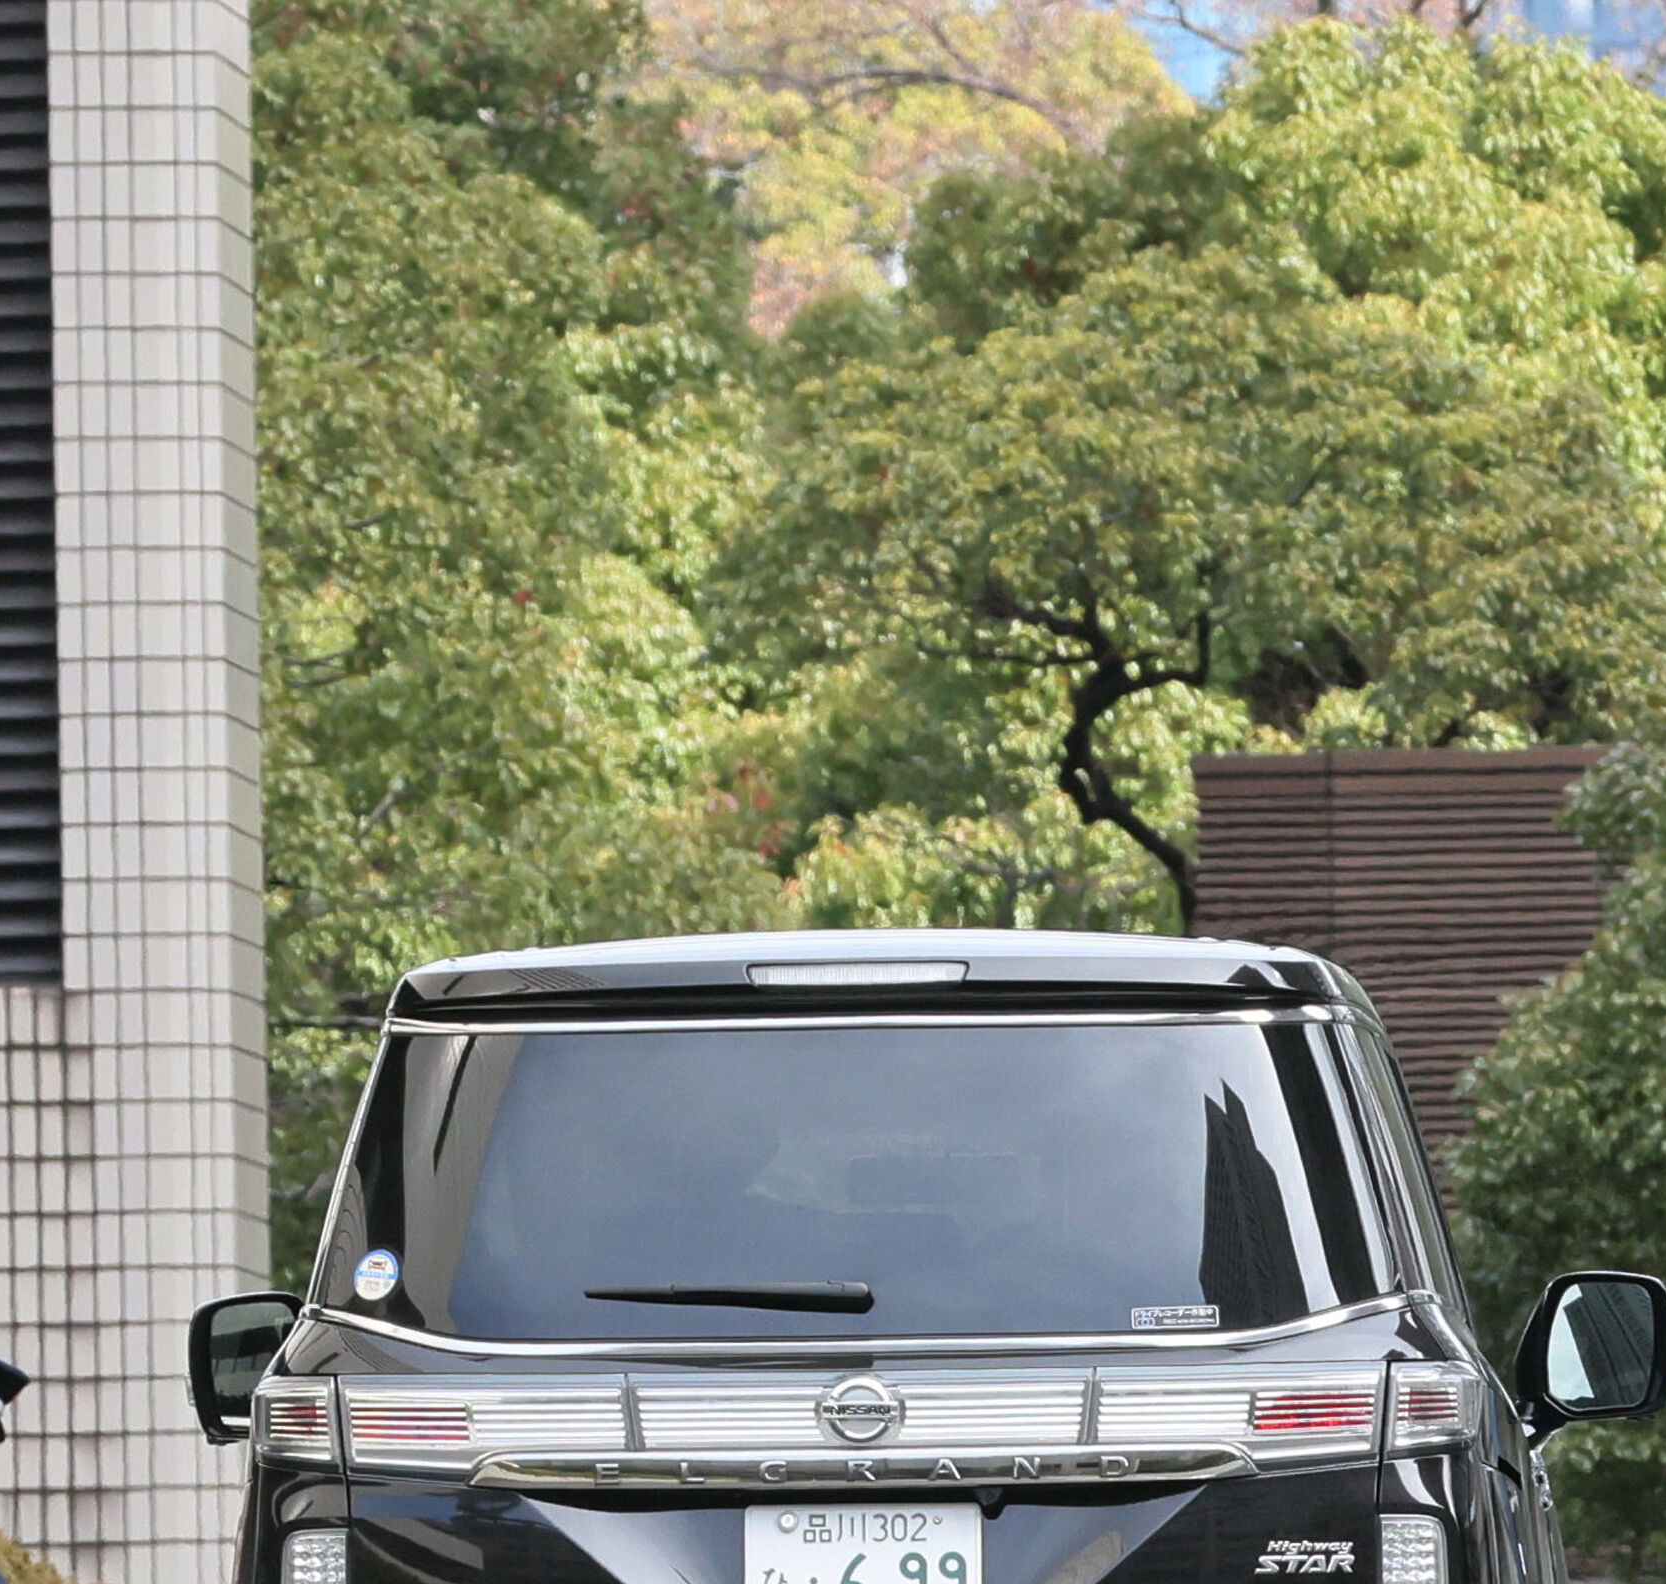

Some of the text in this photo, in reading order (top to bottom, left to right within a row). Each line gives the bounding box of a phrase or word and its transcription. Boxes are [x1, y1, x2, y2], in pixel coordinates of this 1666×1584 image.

[830, 1404, 891, 1416] NISSAN
[594, 1455, 1129, 1486] ELGRAND
[1266, 1539, 1354, 1555] Highway
[1253, 1554, 1356, 1575] STAR
